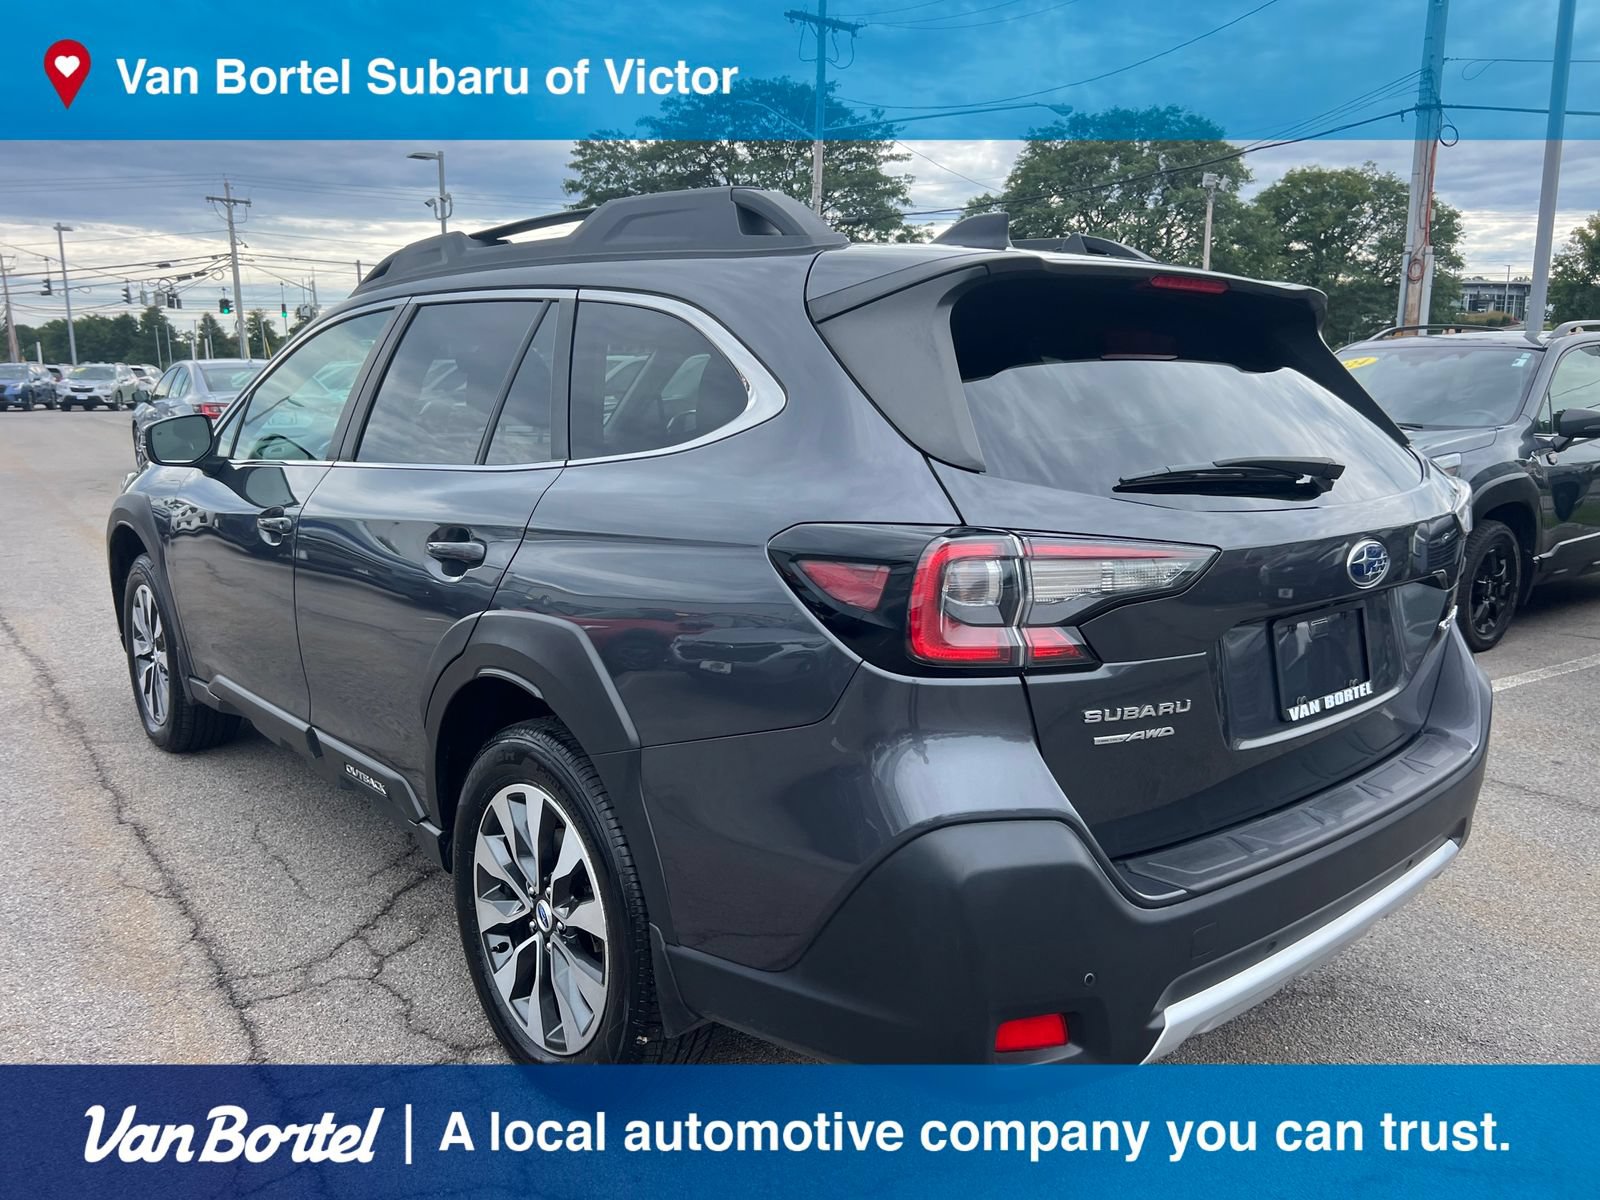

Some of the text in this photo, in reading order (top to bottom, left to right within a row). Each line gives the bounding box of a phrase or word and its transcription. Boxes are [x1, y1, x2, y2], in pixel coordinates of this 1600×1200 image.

[1083, 698, 1192, 724] SUBARU
[1287, 681, 1373, 722] VAN BORTEL
[1125, 726, 1176, 743] AWD
[344, 763, 388, 795] OUTBACK
